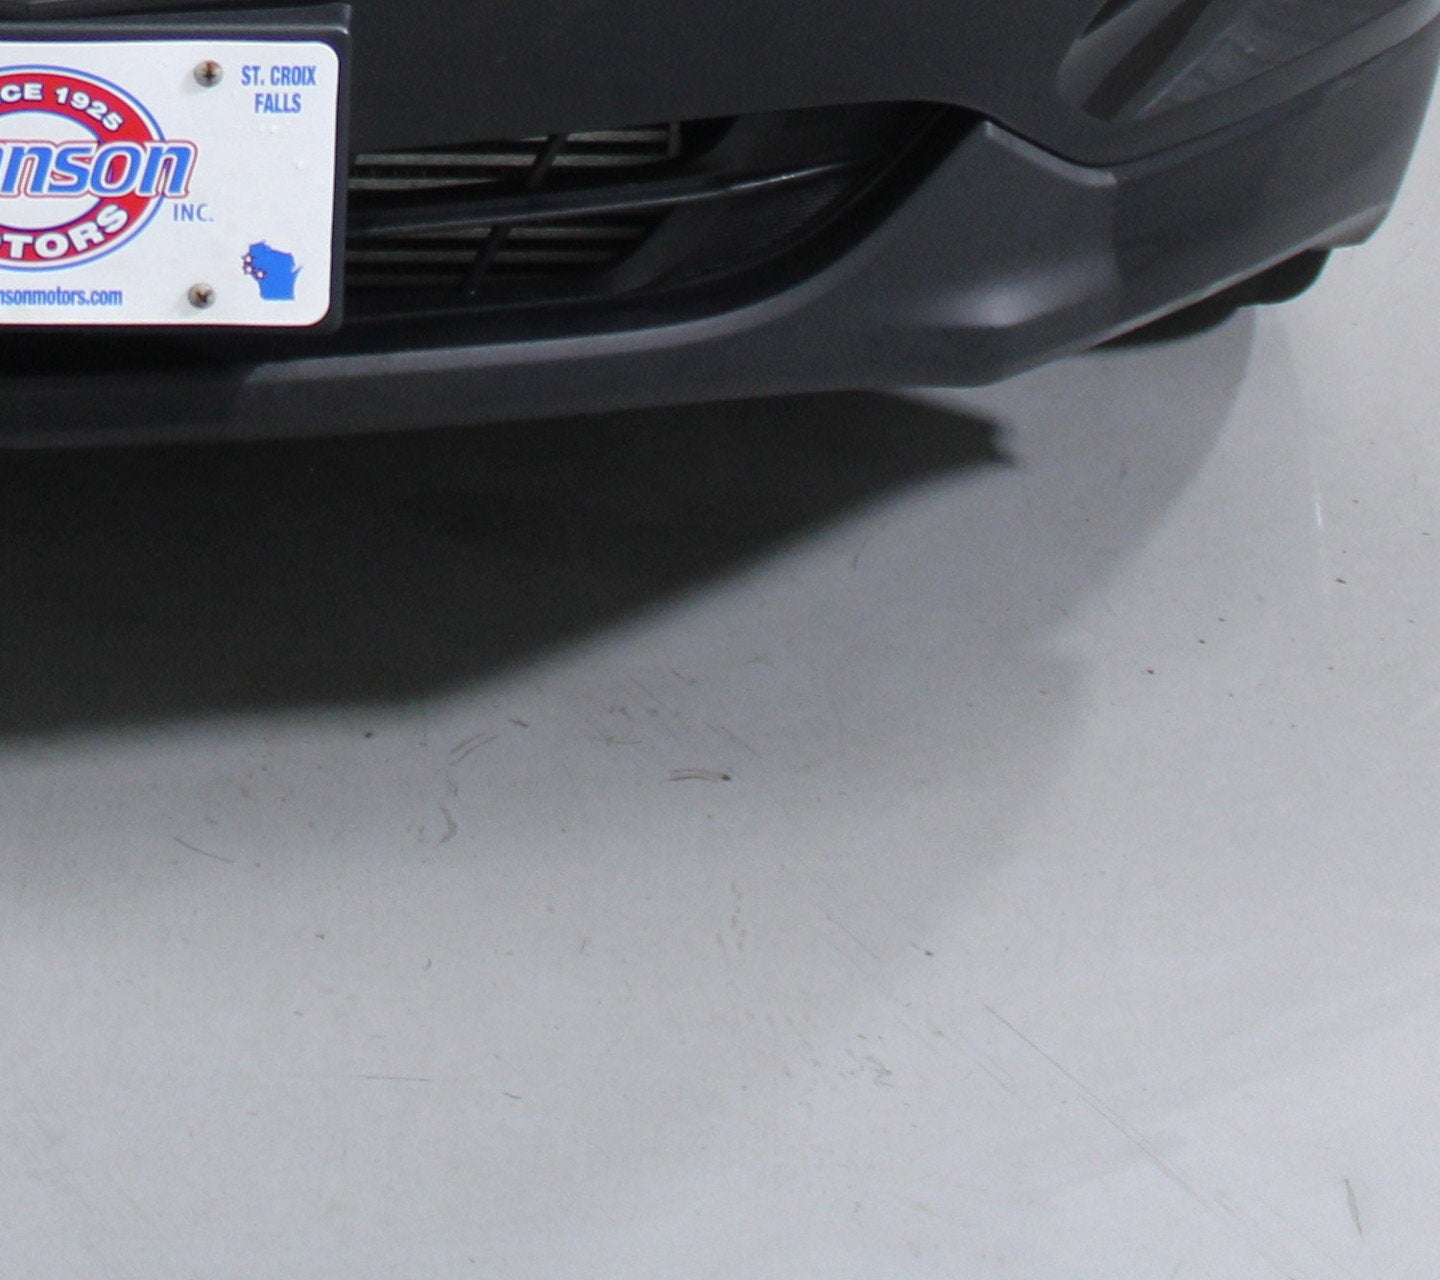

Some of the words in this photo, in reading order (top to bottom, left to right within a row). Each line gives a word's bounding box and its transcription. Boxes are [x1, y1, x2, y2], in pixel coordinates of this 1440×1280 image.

[241, 66, 265, 87] ST.
[270, 66, 317, 87] CROIX
[54, 87, 122, 132] 1925
[254, 93, 301, 114] FALLS
[173, 204, 214, 222] INC.
